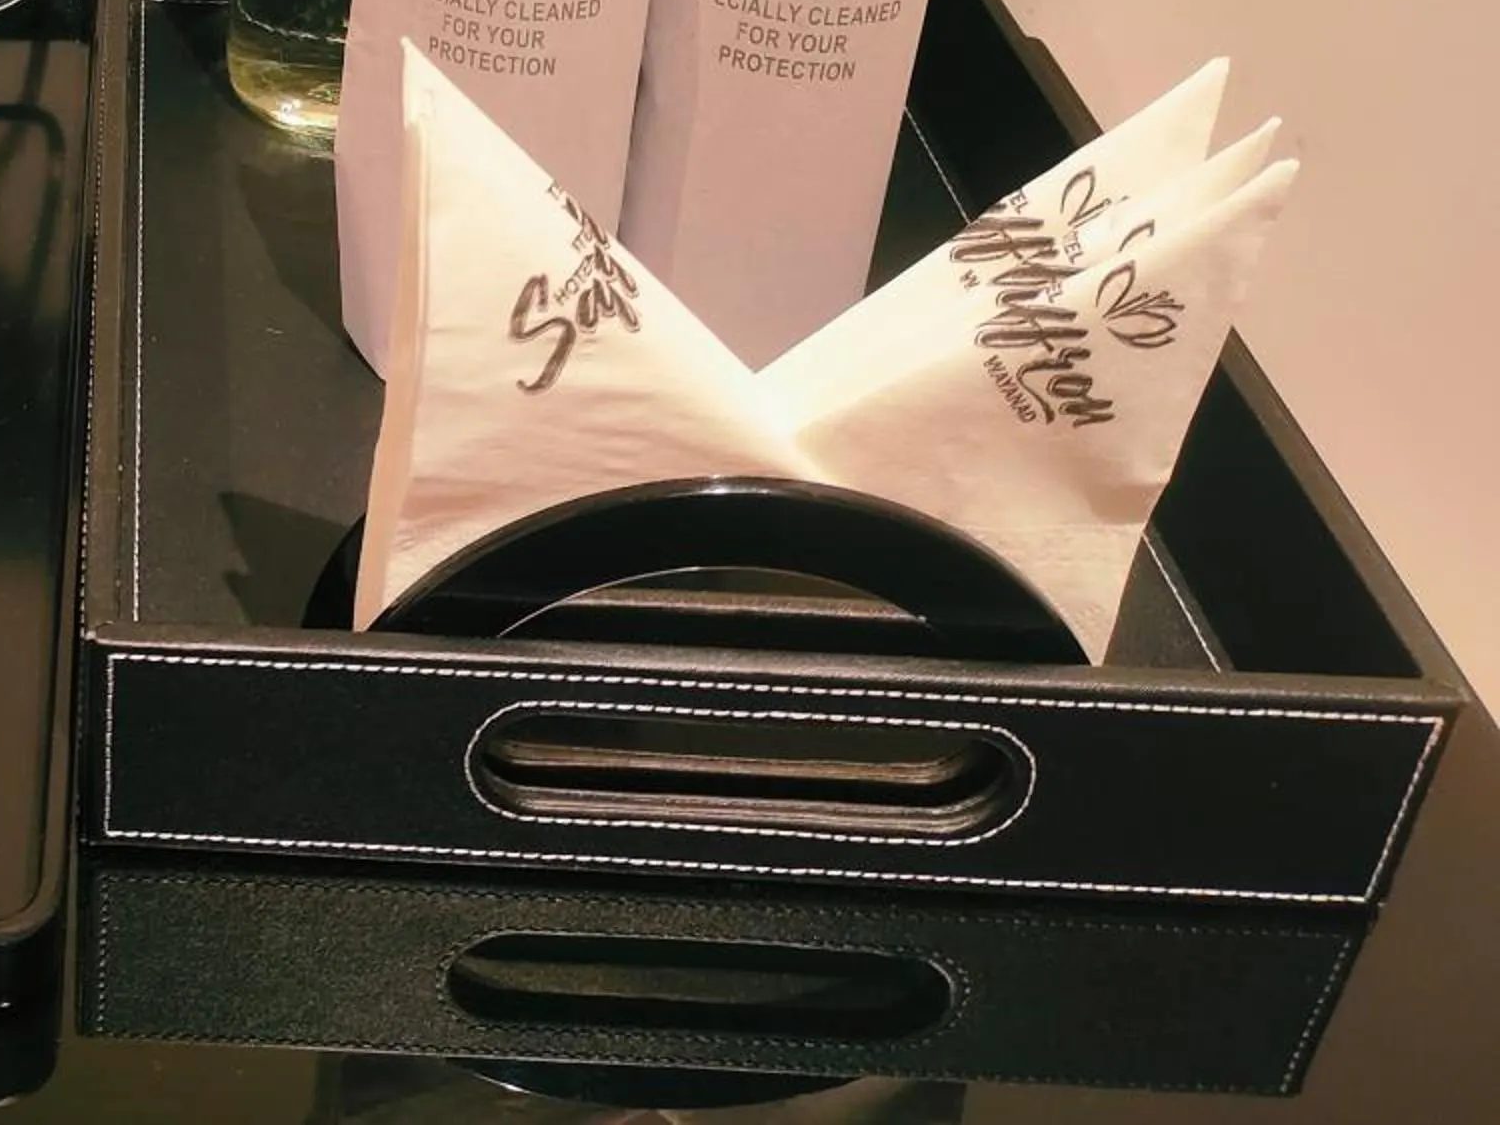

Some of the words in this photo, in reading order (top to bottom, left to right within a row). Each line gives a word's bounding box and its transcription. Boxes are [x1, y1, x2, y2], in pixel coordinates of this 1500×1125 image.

[808, 0, 901, 26] CLEANED
[442, 14, 480, 41] FOR
[487, 26, 546, 49] YOUR
[736, 22, 780, 49] FOR
[787, 32, 848, 53] YOUR
[429, 36, 557, 75] PROTECTION
[718, 45, 856, 81] PROTECTION
